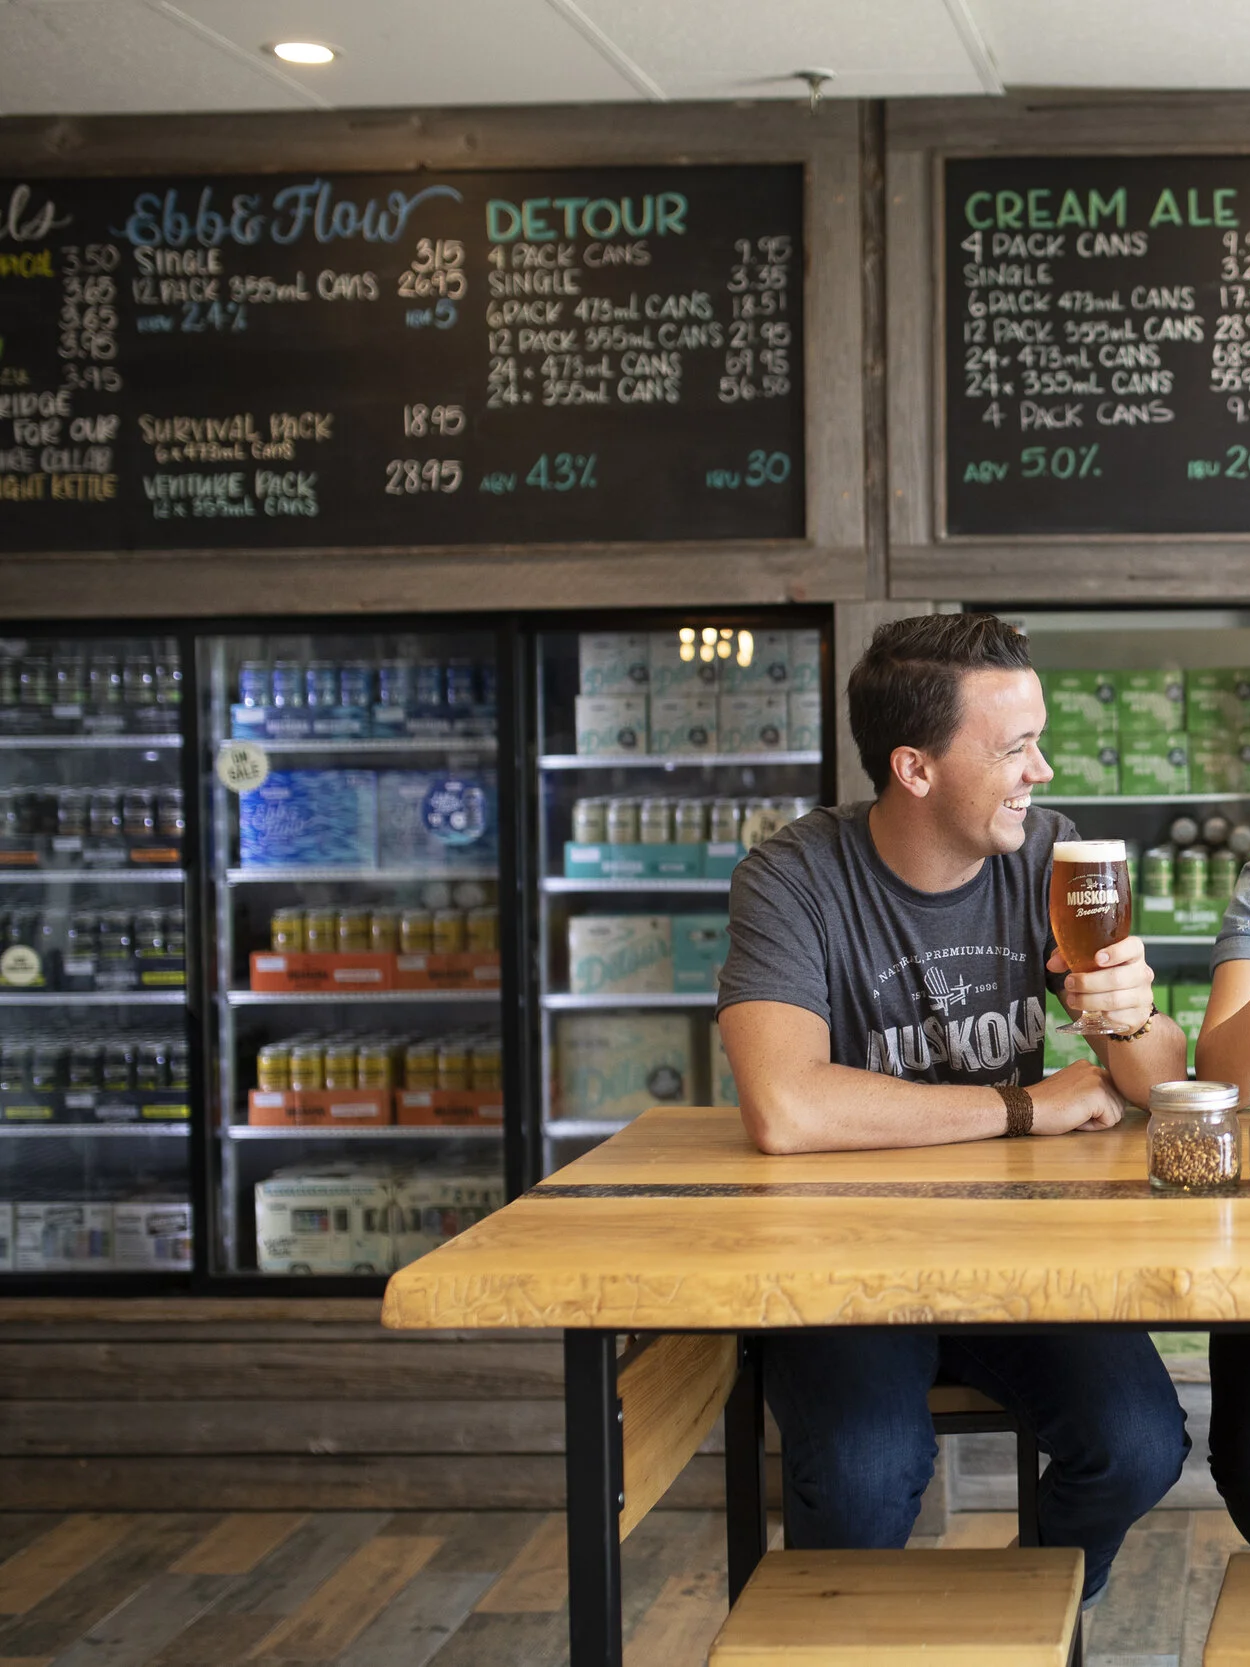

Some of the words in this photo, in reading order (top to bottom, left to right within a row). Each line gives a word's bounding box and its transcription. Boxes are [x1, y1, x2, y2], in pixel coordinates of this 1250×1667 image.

[486, 192, 688, 242] DETOUR
[965, 187, 1128, 230] CREAM
[1150, 187, 1240, 228] ALE
[133, 246, 223, 276] SINGLE
[488, 244, 505, 270] 4
[511, 243, 576, 267] PACK
[582, 241, 651, 267] CANS
[733, 235, 792, 264] 9.95
[960, 231, 984, 264] 4
[992, 233, 1065, 258] PACK
[1076, 231, 1149, 259] CANS
[160, 279, 220, 301] PACK
[316, 270, 379, 300] CANS
[488, 268, 582, 297] SINGLE
[963, 262, 1053, 288] SINGLE
[486, 300, 502, 328] 6
[502, 300, 563, 324] PACK
[644, 290, 714, 321] CANS
[968, 290, 987, 318] 6
[988, 290, 1052, 315] PACK
[1131, 285, 1196, 311] CANS
[488, 329, 512, 354] 12
[518, 327, 578, 353] PACK
[658, 322, 725, 348] CANS
[963, 321, 986, 344] 12
[993, 318, 1055, 344] PACK
[1143, 316, 1205, 342] CANS
[620, 351, 683, 378] CANS
[1099, 343, 1161, 370] CANS
[617, 376, 681, 404] CANS
[1111, 371, 1174, 395] CANS
[138, 414, 259, 442] SURVIVAL
[270, 412, 334, 442] PACK
[404, 404, 466, 437] 18.95
[982, 401, 1007, 429] 4
[1020, 401, 1084, 432] PACK
[1096, 399, 1176, 426] CANS
[256, 469, 319, 498] PACK
[385, 458, 462, 494] 28.95
[745, 449, 791, 487] 30
[963, 460, 1008, 484] ABV
[1067, 888, 1119, 907] MUSKOKA
[1075, 904, 1111, 917] Brewery
[925, 945, 983, 961] PREMIUM
[867, 995, 1045, 1077] MUSKOKA
